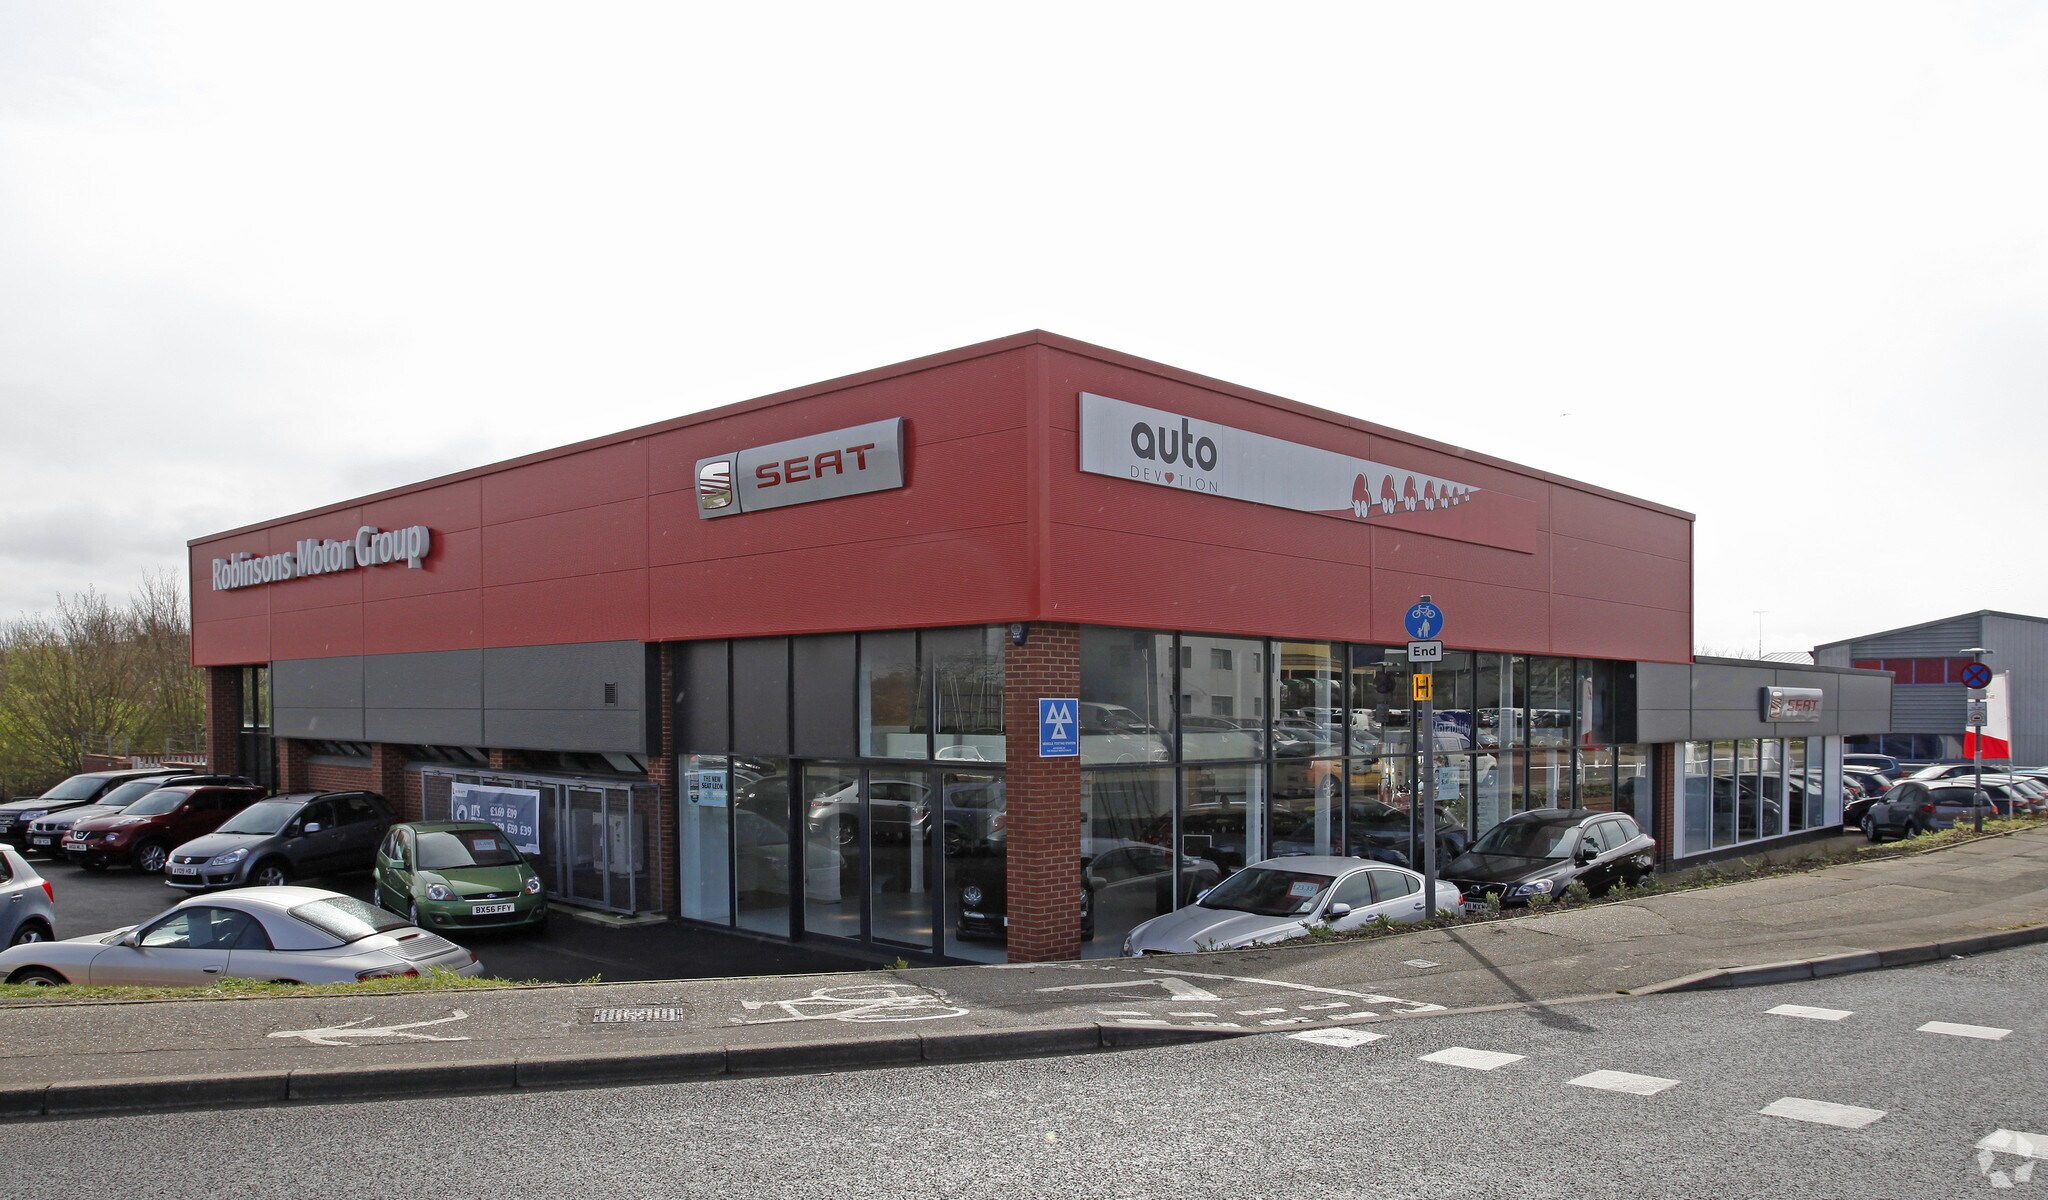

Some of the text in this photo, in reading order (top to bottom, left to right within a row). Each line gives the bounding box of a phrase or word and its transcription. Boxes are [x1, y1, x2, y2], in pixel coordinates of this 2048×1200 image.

[1131, 417, 1217, 472] auto
[755, 443, 875, 488] SEAT
[212, 525, 430, 591] Robinsons Motor Group
[1414, 646, 1436, 656] End
[1415, 676, 1429, 698] H
[1786, 699, 1820, 711] SEAT
[475, 904, 512, 914] BX56 FFY
